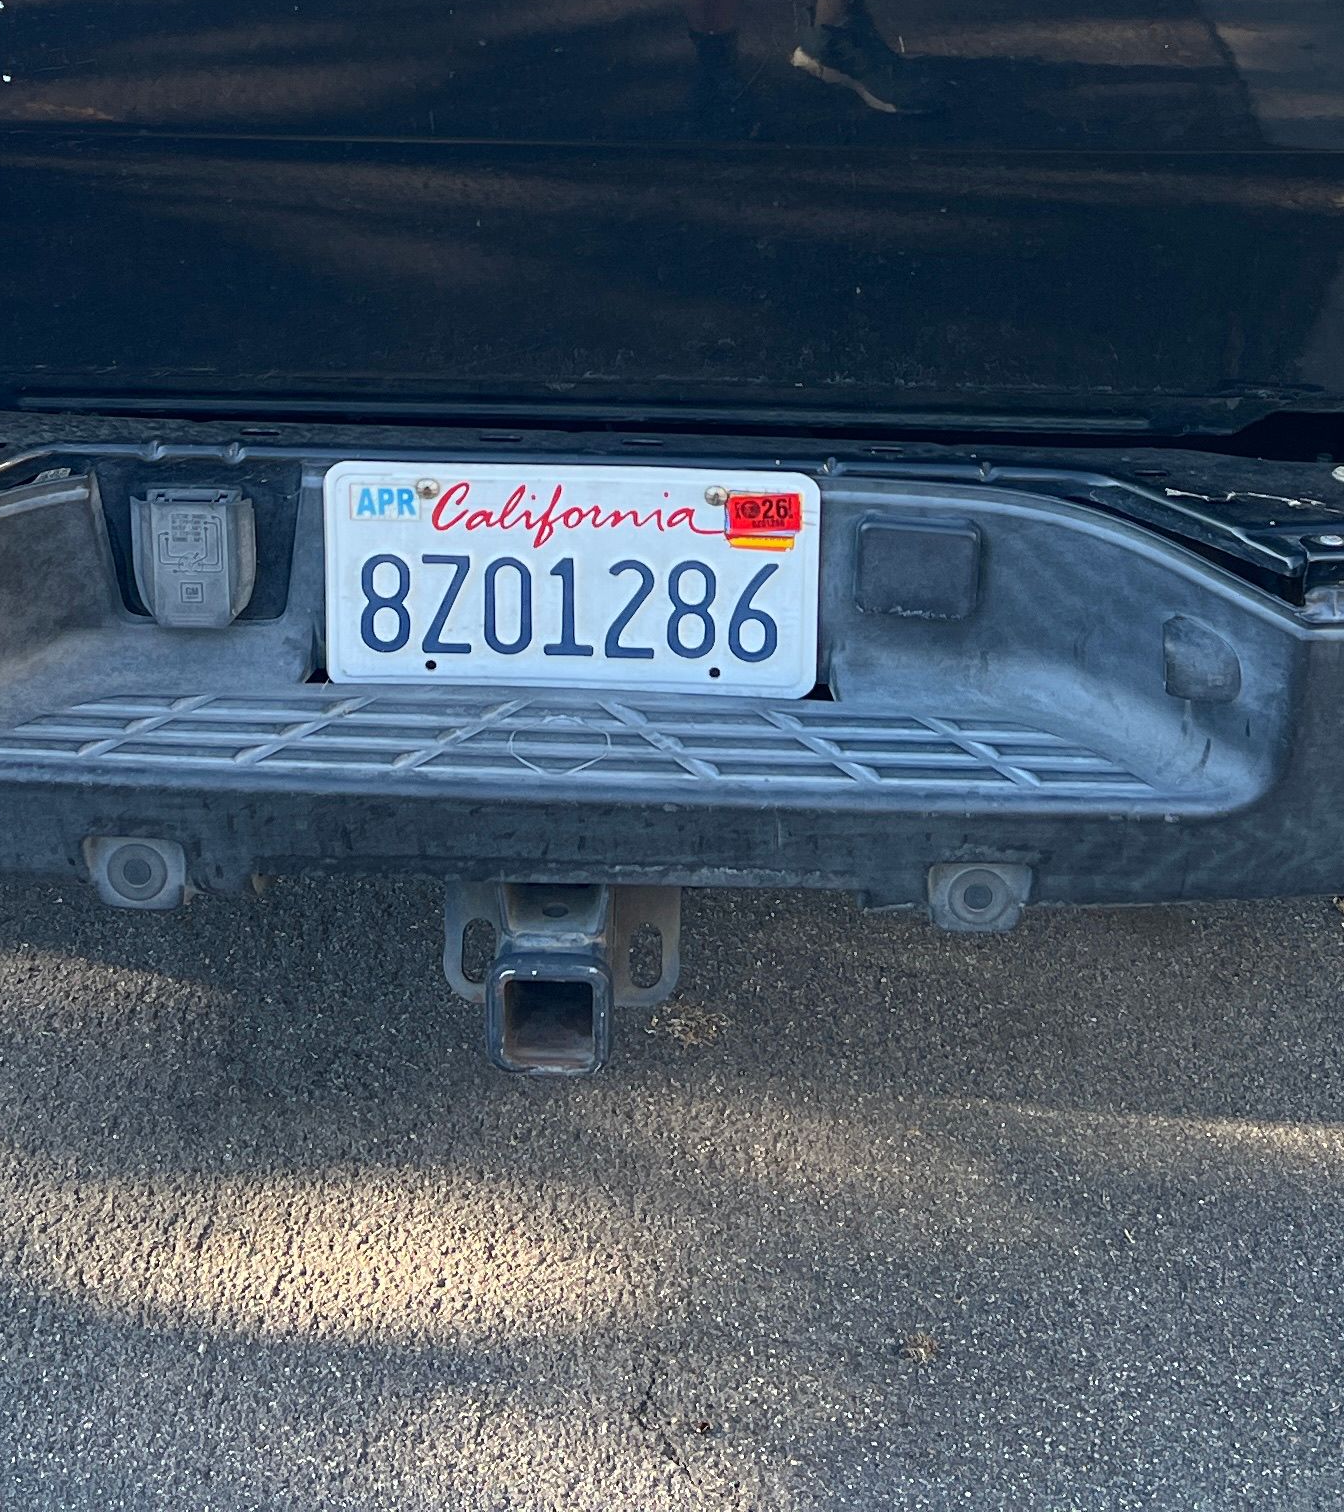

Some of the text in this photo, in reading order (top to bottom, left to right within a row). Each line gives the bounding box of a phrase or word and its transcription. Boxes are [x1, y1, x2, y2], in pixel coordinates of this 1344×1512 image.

[356, 487, 417, 516] APR
[432, 482, 726, 549] California
[761, 498, 788, 520] 26
[360, 553, 780, 663] 8Z01286
